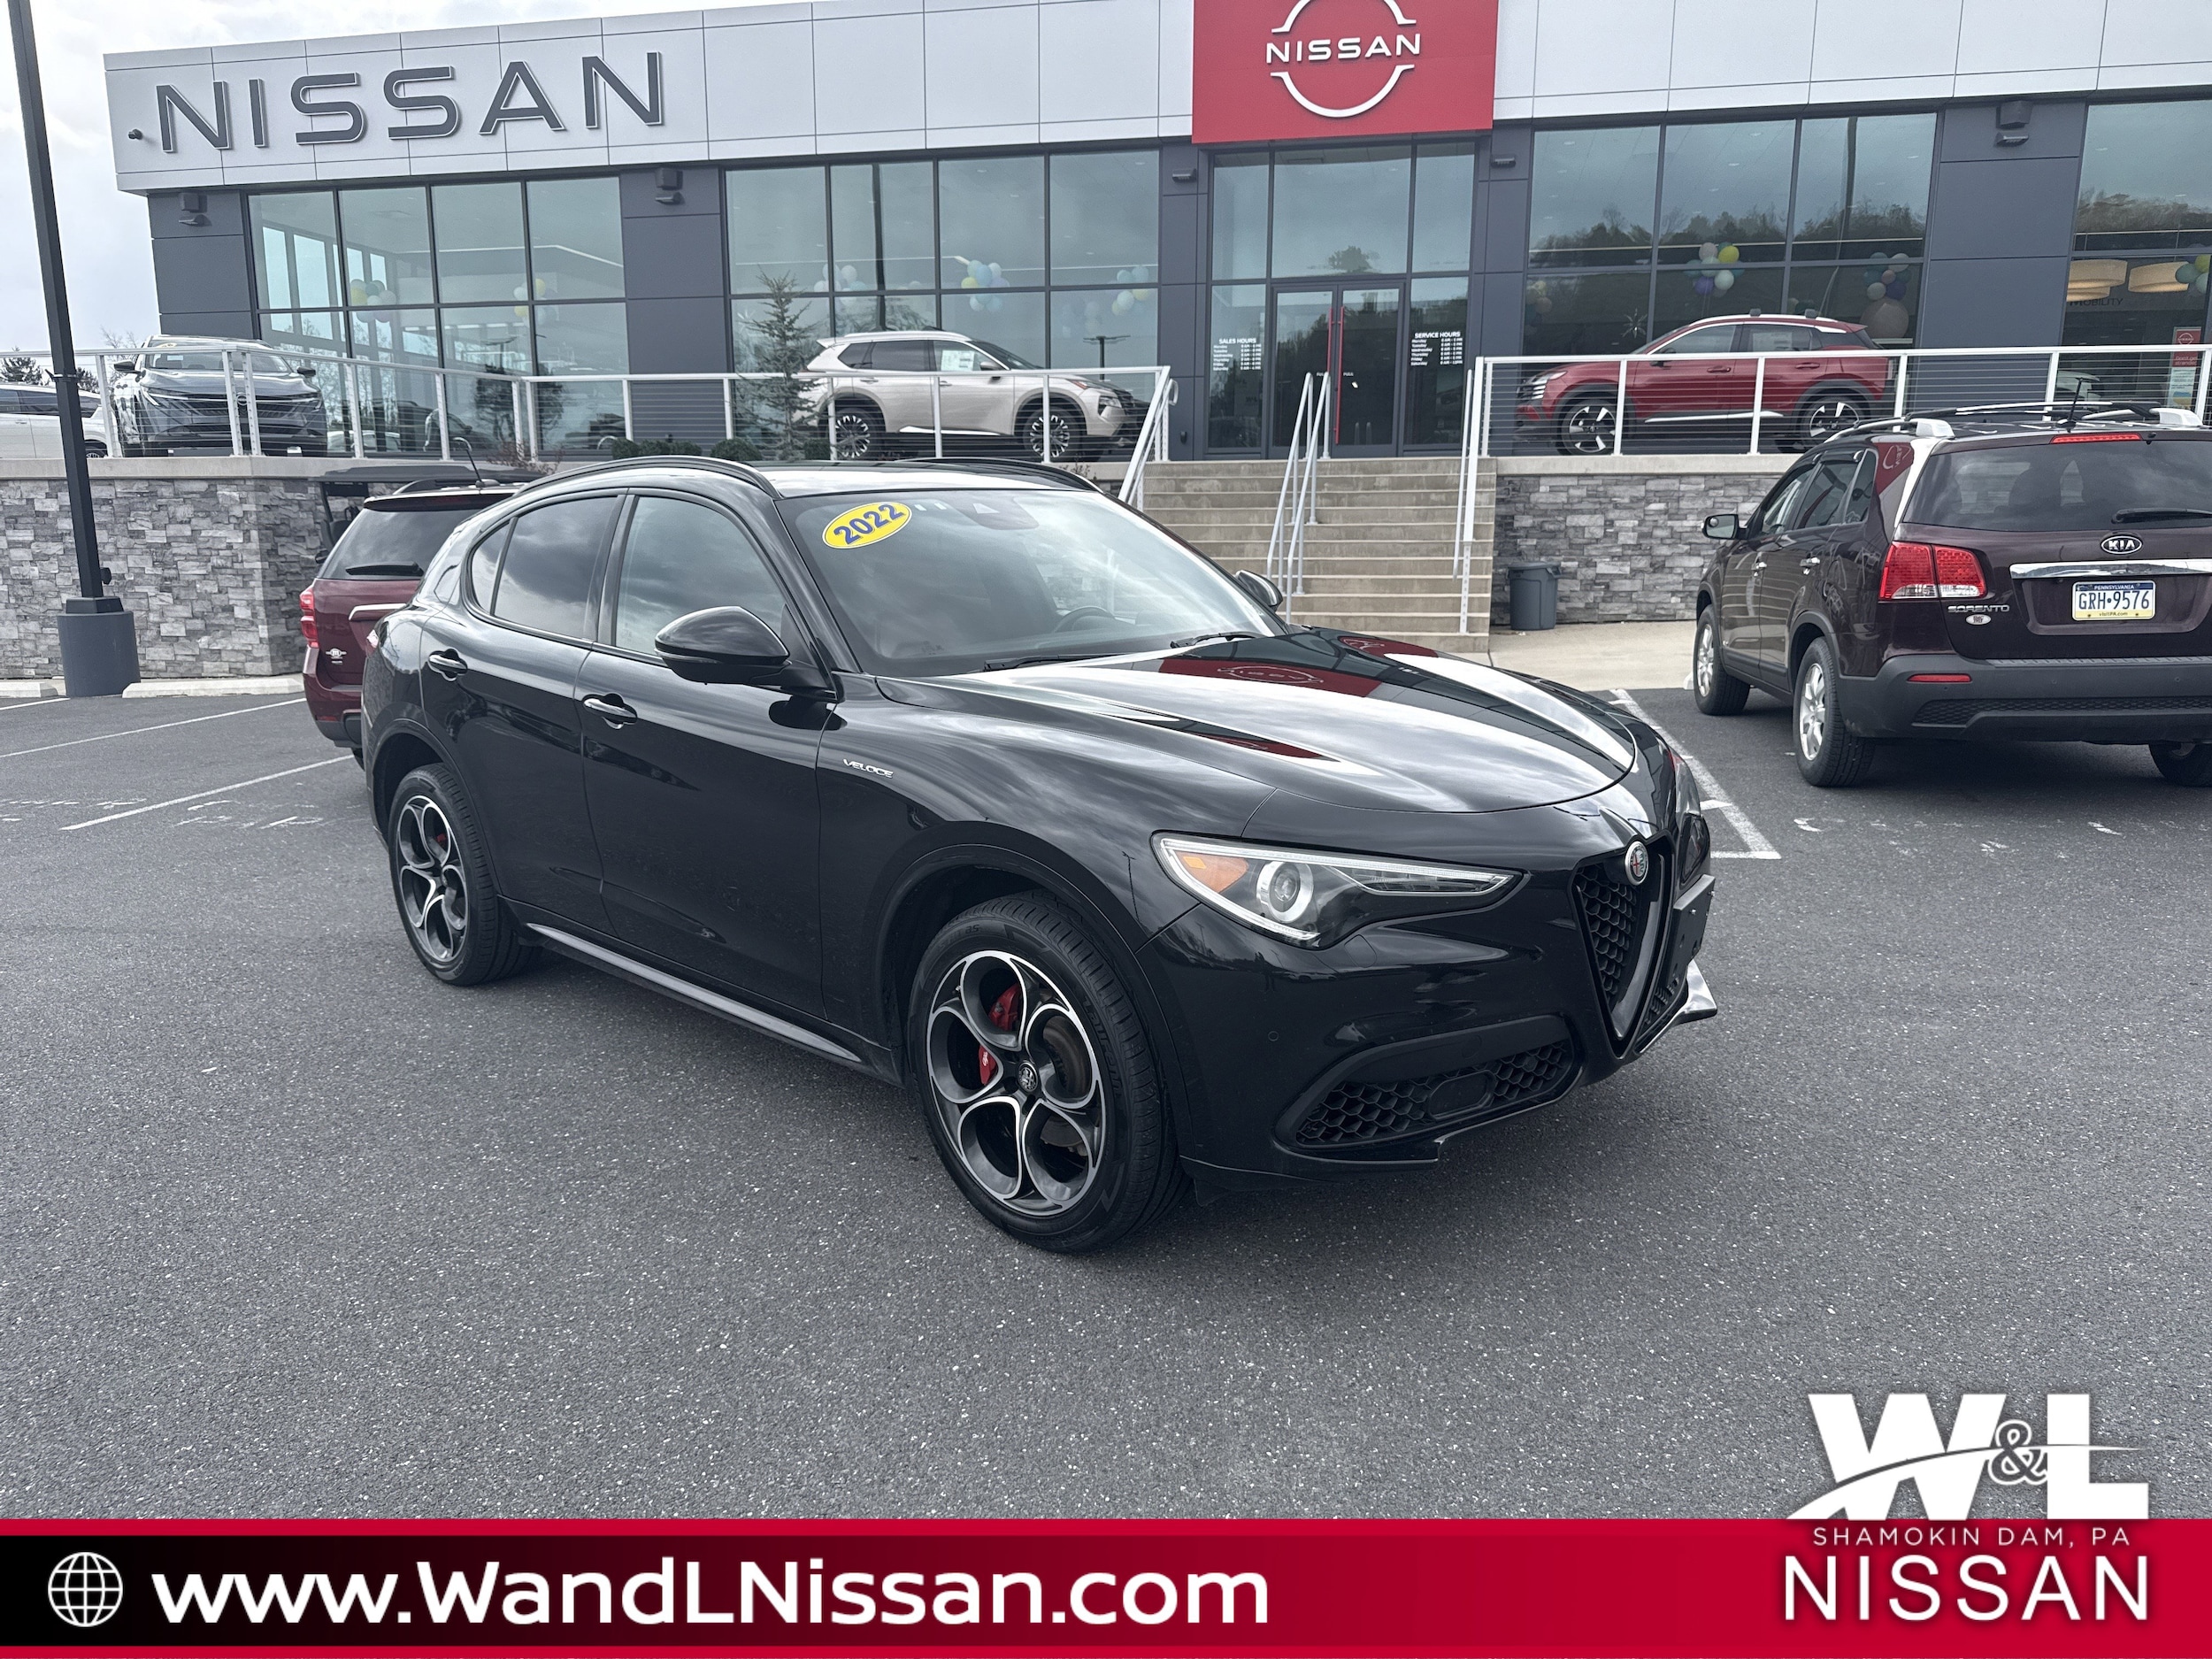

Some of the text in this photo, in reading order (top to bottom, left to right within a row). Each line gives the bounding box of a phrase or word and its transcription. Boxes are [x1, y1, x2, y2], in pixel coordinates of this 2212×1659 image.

[1266, 33, 1421, 65] NISSAN
[156, 51, 663, 152] NISSAN
[833, 503, 906, 545] 2022
[2108, 540, 2136, 550] KIA
[1947, 604, 2010, 613] SORENTO
[843, 758, 894, 779] VELOCE
